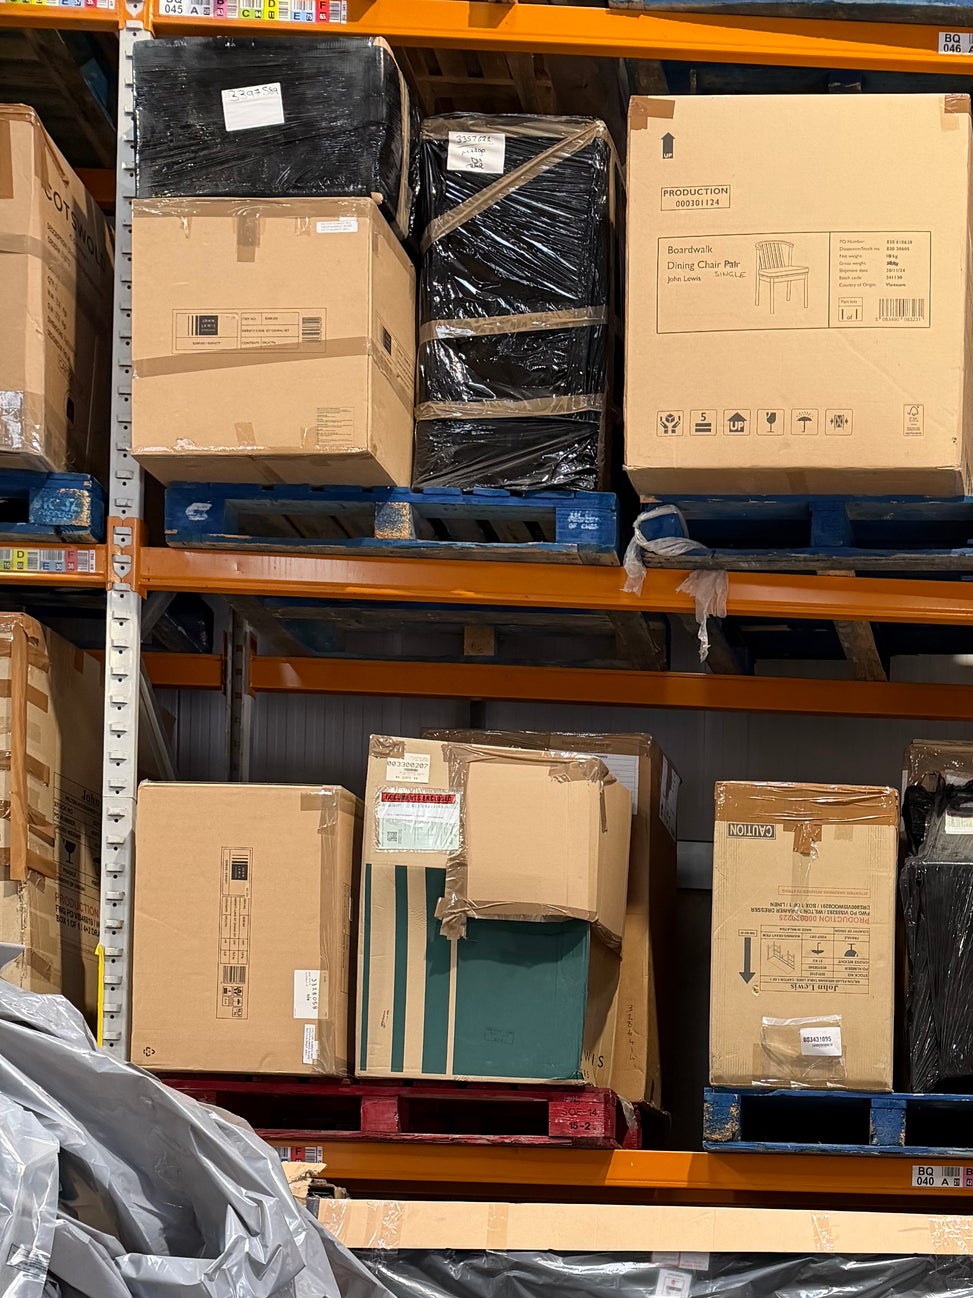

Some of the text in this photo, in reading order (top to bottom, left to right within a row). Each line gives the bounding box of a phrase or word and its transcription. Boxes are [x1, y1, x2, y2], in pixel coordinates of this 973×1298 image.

[320, 1, 326, 9] F
[165, 5, 183, 14] 045
[191, 7, 198, 15] A
[242, 9, 249, 17] C
[945, 34, 961, 43] BQ
[943, 44, 961, 53] 046
[663, 188, 728, 197] PRODUCTION
[676, 199, 719, 207] 000301124
[667, 245, 713, 254] Boardwalk
[667, 261, 695, 271] Dining
[698, 260, 721, 269] Chair
[667, 276, 682, 284] John
[700, 412, 707, 422] 5
[730, 421, 745, 431] UP
[729, 824, 773, 837] CAUTION
[819, 915, 869, 924] PRODUCTION
[791, 983, 839, 992] John Lewis
[918, 1167, 934, 1176] BQ
[917, 1177, 934, 1186] 040
[941, 1178, 948, 1186] A
